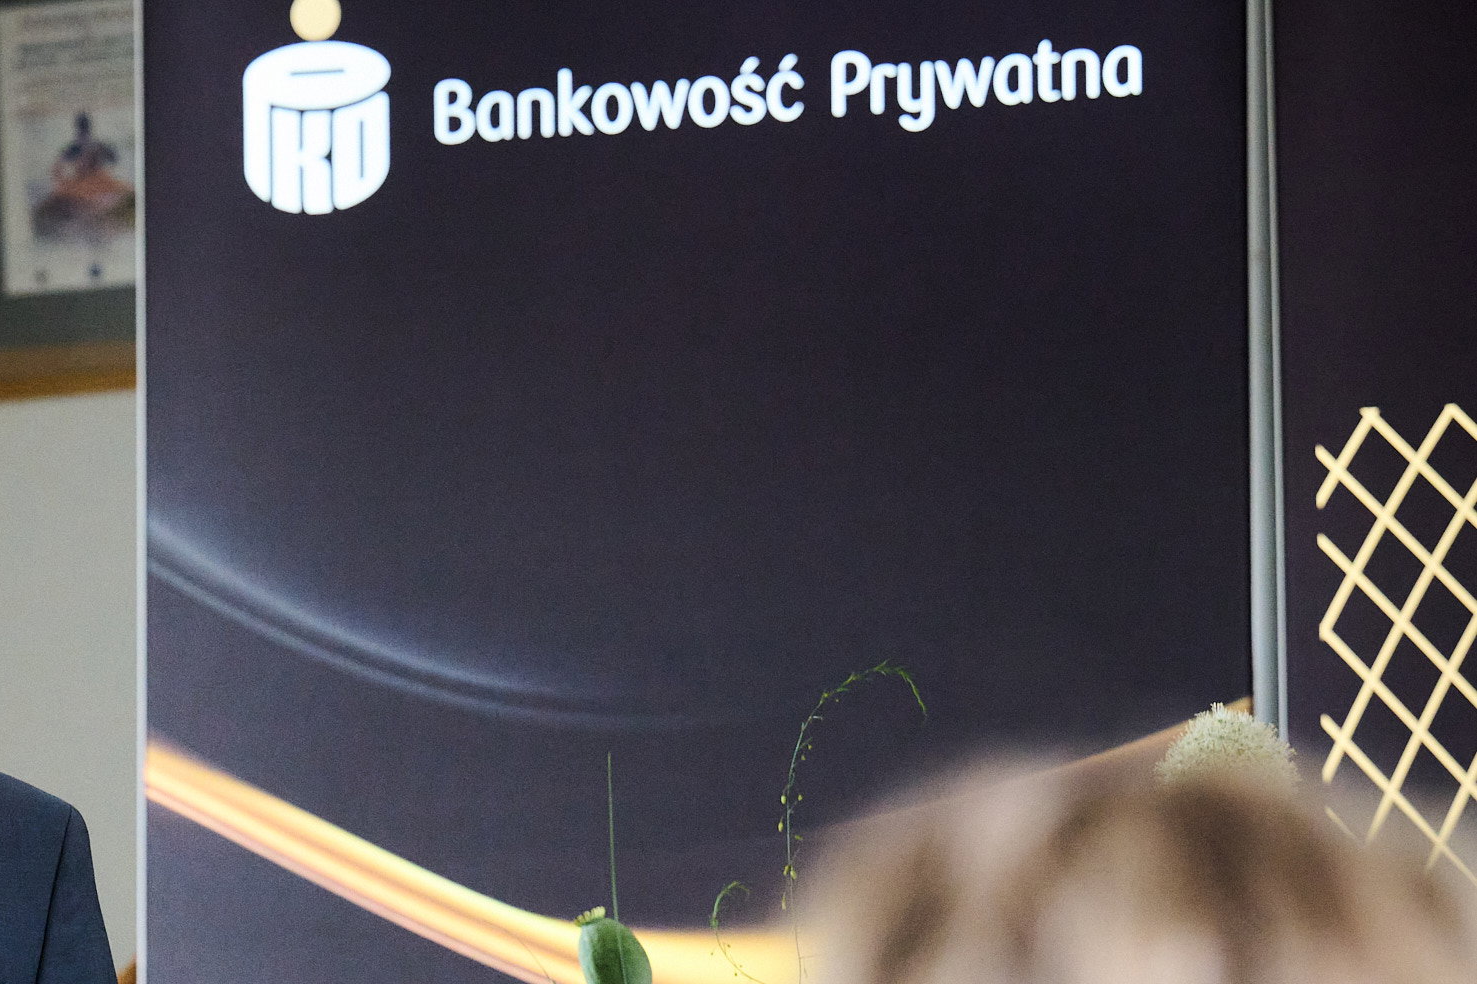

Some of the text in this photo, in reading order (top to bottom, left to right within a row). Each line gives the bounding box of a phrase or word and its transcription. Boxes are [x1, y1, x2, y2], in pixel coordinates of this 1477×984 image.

[242, 40, 392, 216] PKO
[433, 38, 1143, 146] Bankowość Prywatna
